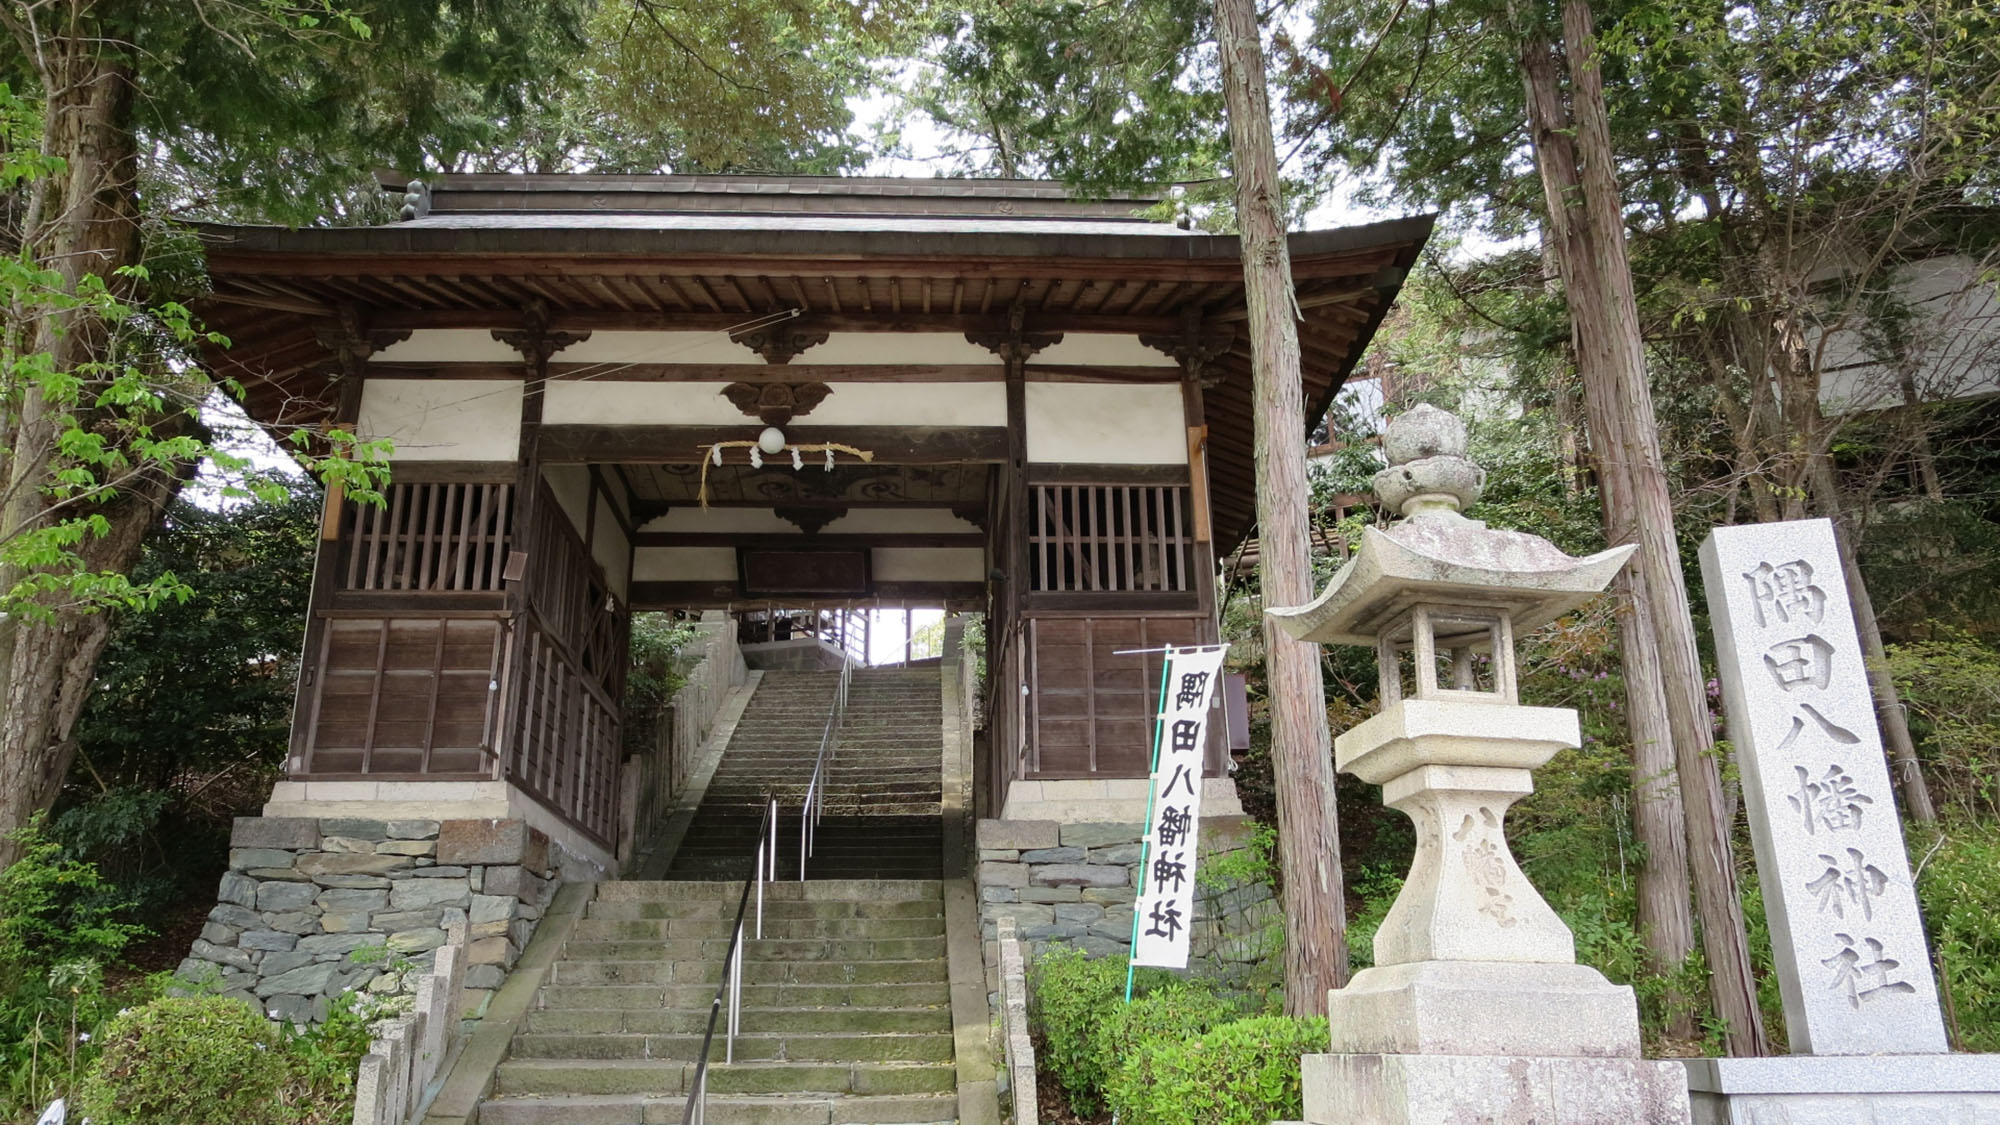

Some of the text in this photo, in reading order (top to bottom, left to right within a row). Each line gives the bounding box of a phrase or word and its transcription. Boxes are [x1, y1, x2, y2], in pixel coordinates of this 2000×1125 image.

[1741, 558, 1917, 1010] 隅田八幡神社
